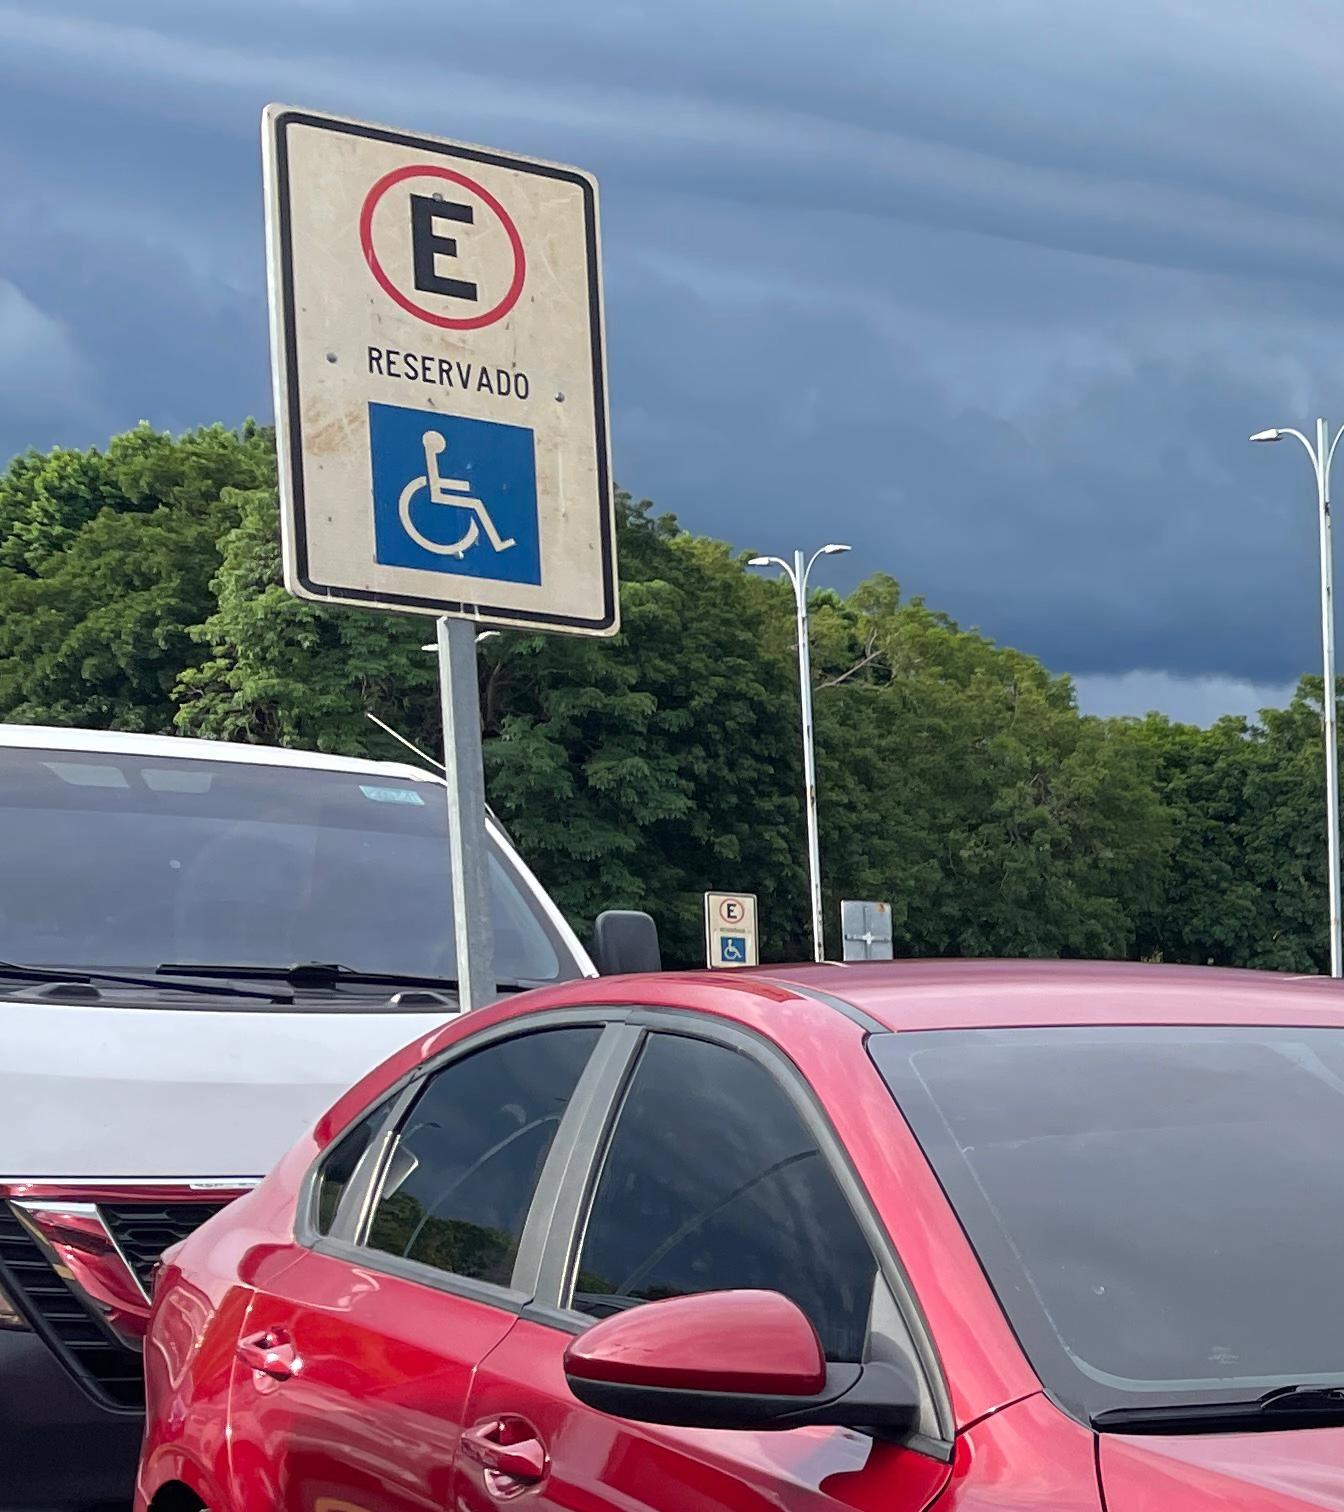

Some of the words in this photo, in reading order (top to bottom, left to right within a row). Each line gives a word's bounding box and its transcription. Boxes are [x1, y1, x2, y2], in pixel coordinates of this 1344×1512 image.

[409, 193, 478, 302] E
[367, 345, 530, 400] RESERVADO
[726, 903, 738, 919] E
